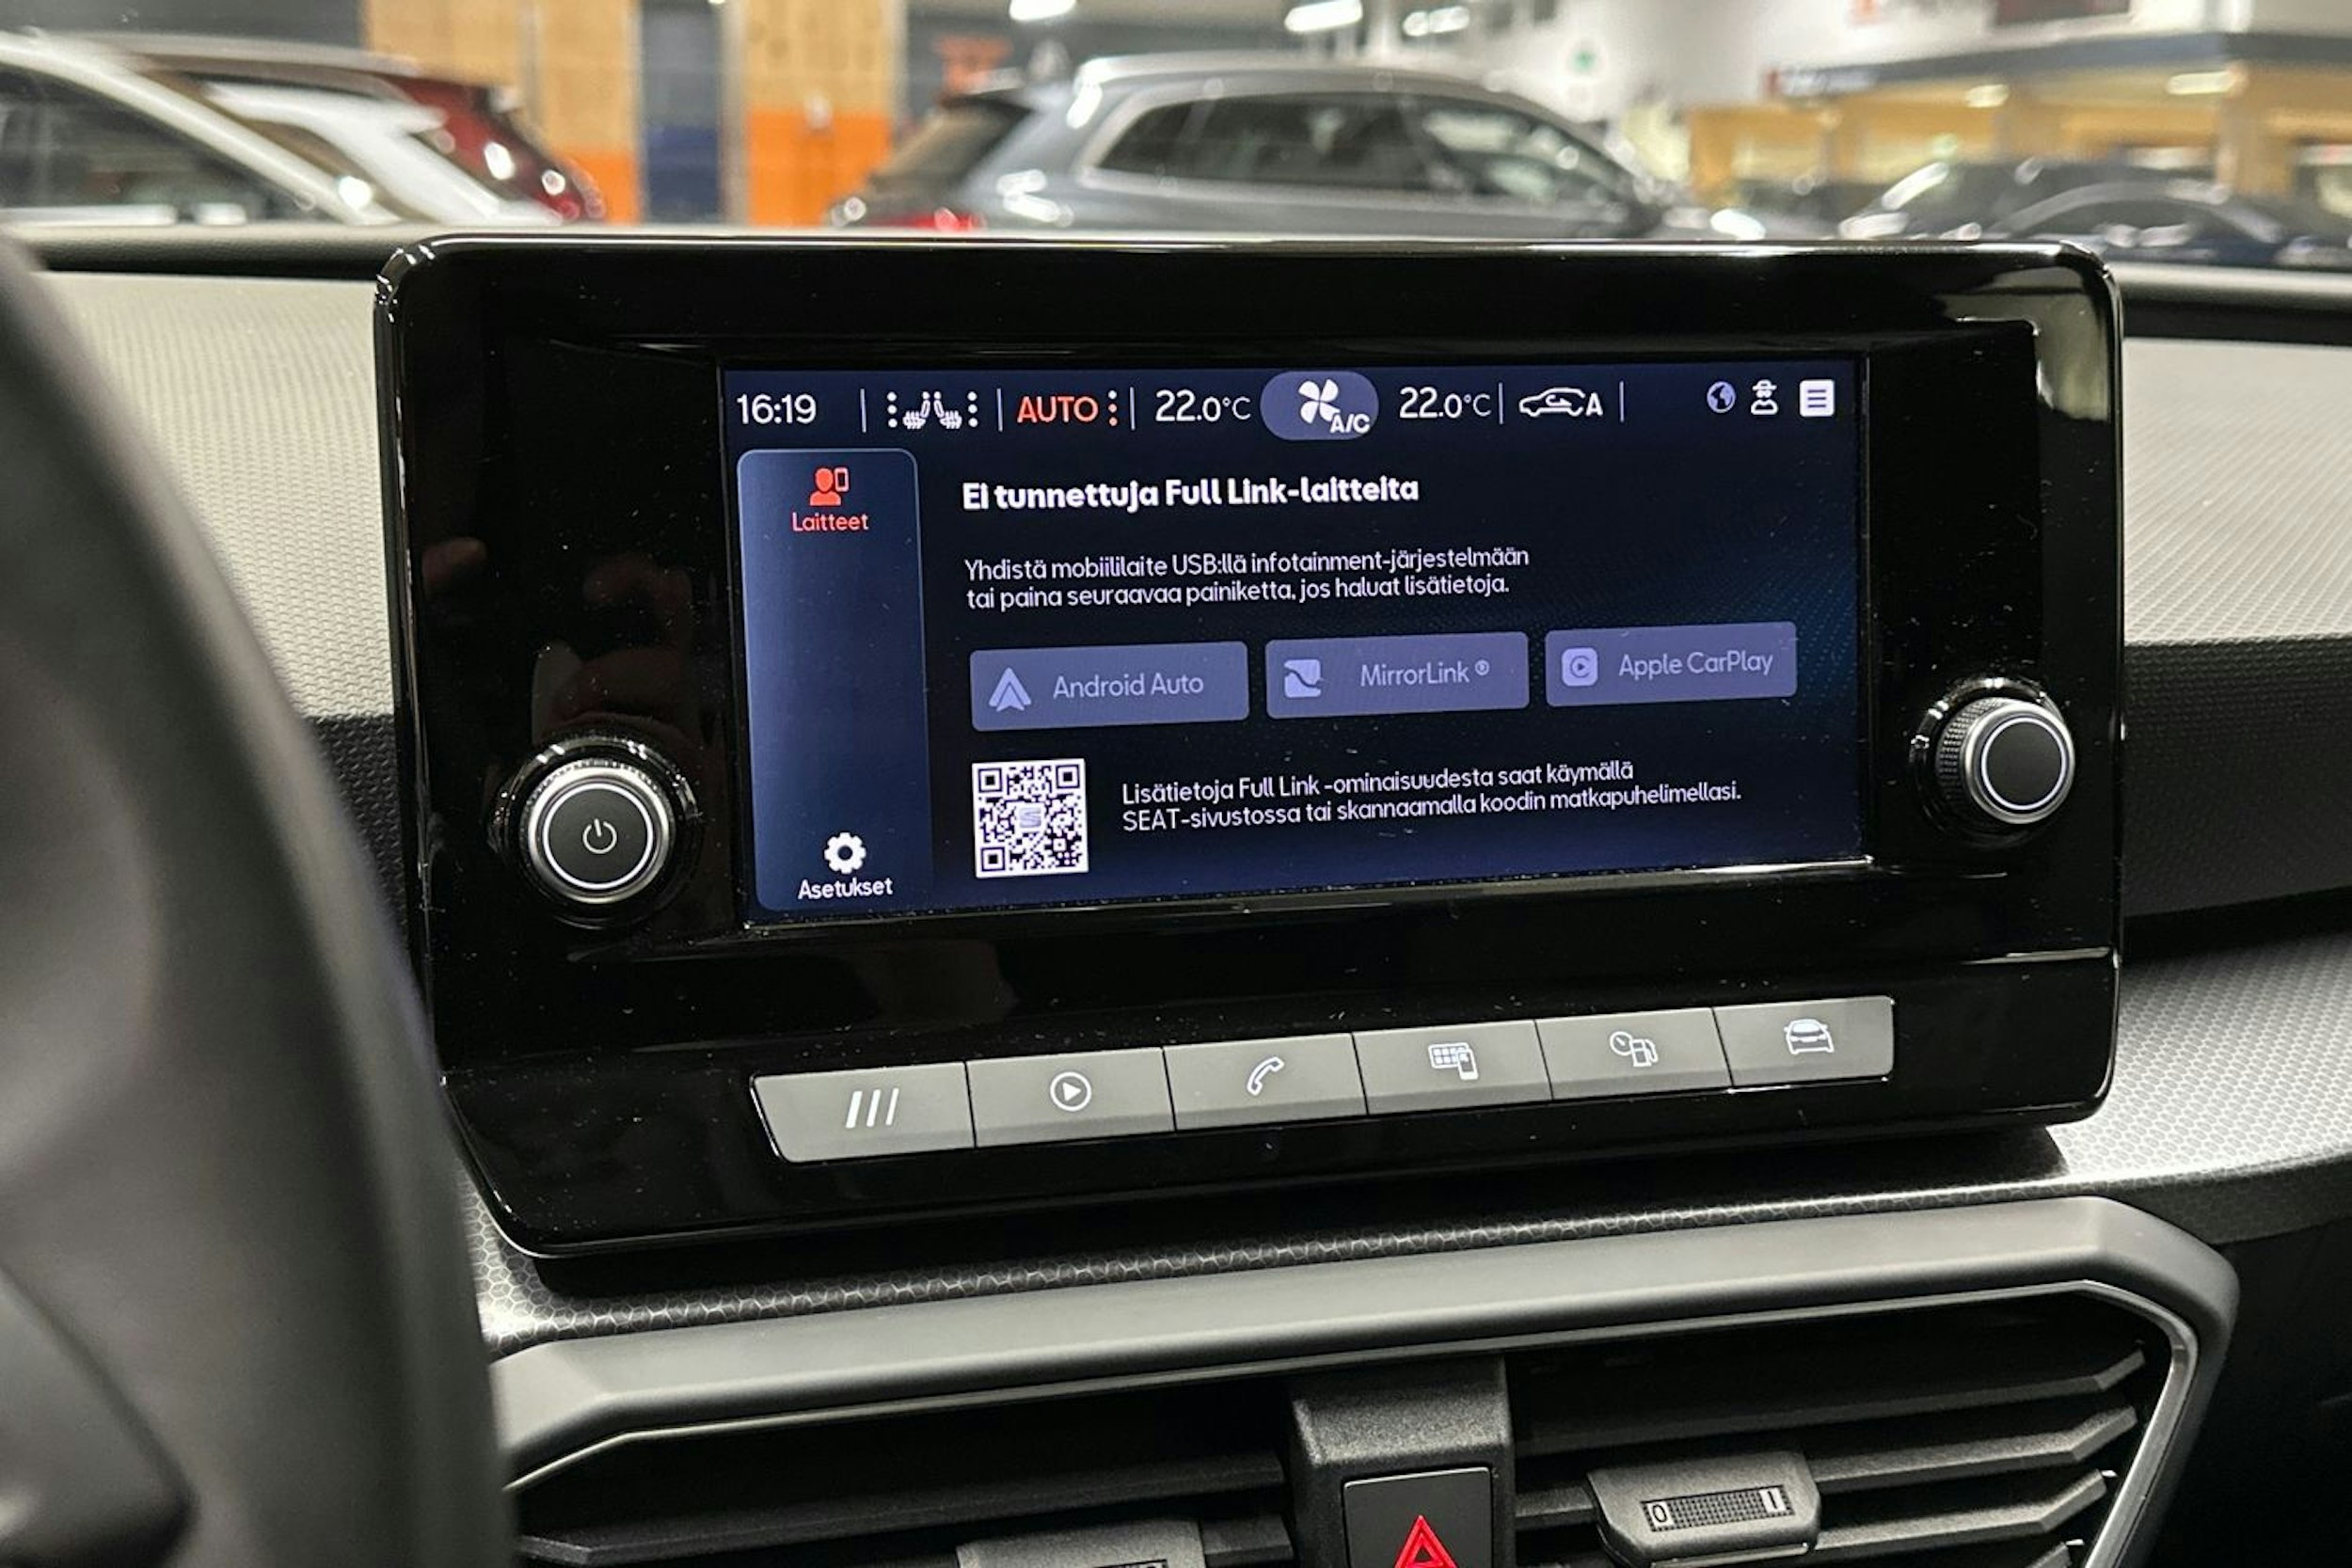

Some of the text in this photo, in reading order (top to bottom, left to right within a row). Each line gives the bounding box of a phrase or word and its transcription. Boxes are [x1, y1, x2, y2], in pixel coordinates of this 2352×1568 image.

[737, 393, 817, 424] 16:19
[1016, 395, 1099, 423] AUTO
[1154, 388, 1251, 422] 22.0°C
[1399, 386, 1491, 420] 22.0°C
[1329, 414, 1371, 435] A/C
[994, 480, 1158, 513] tunnettuja
[1166, 477, 1222, 506] Full
[1228, 475, 1419, 506] Link-laitteita
[792, 512, 869, 532] Laitteet
[965, 547, 1530, 581] Yhdistä mobiililaite USB:llä infotainment-järjestelmään
[967, 589, 994, 610] tai
[1000, 587, 1062, 611] paina
[1067, 588, 1183, 608] seuraavaa
[1300, 578, 1331, 602] jos
[1336, 577, 1400, 599] haluat
[1405, 573, 1510, 599] lisätietoja.
[1360, 663, 1470, 688] MirrorLink
[1618, 649, 1773, 677] Apple CarPlay
[1053, 673, 1205, 700] Android Auto
[1122, 761, 1633, 806] Lisätietoja Full Link -ominaisuudesta saat käymällä
[1122, 780, 1741, 832] SEAT-sivustossa tai skannaamalla koodin matkapuhelimellasi.
[798, 875, 893, 900] Asetukset
